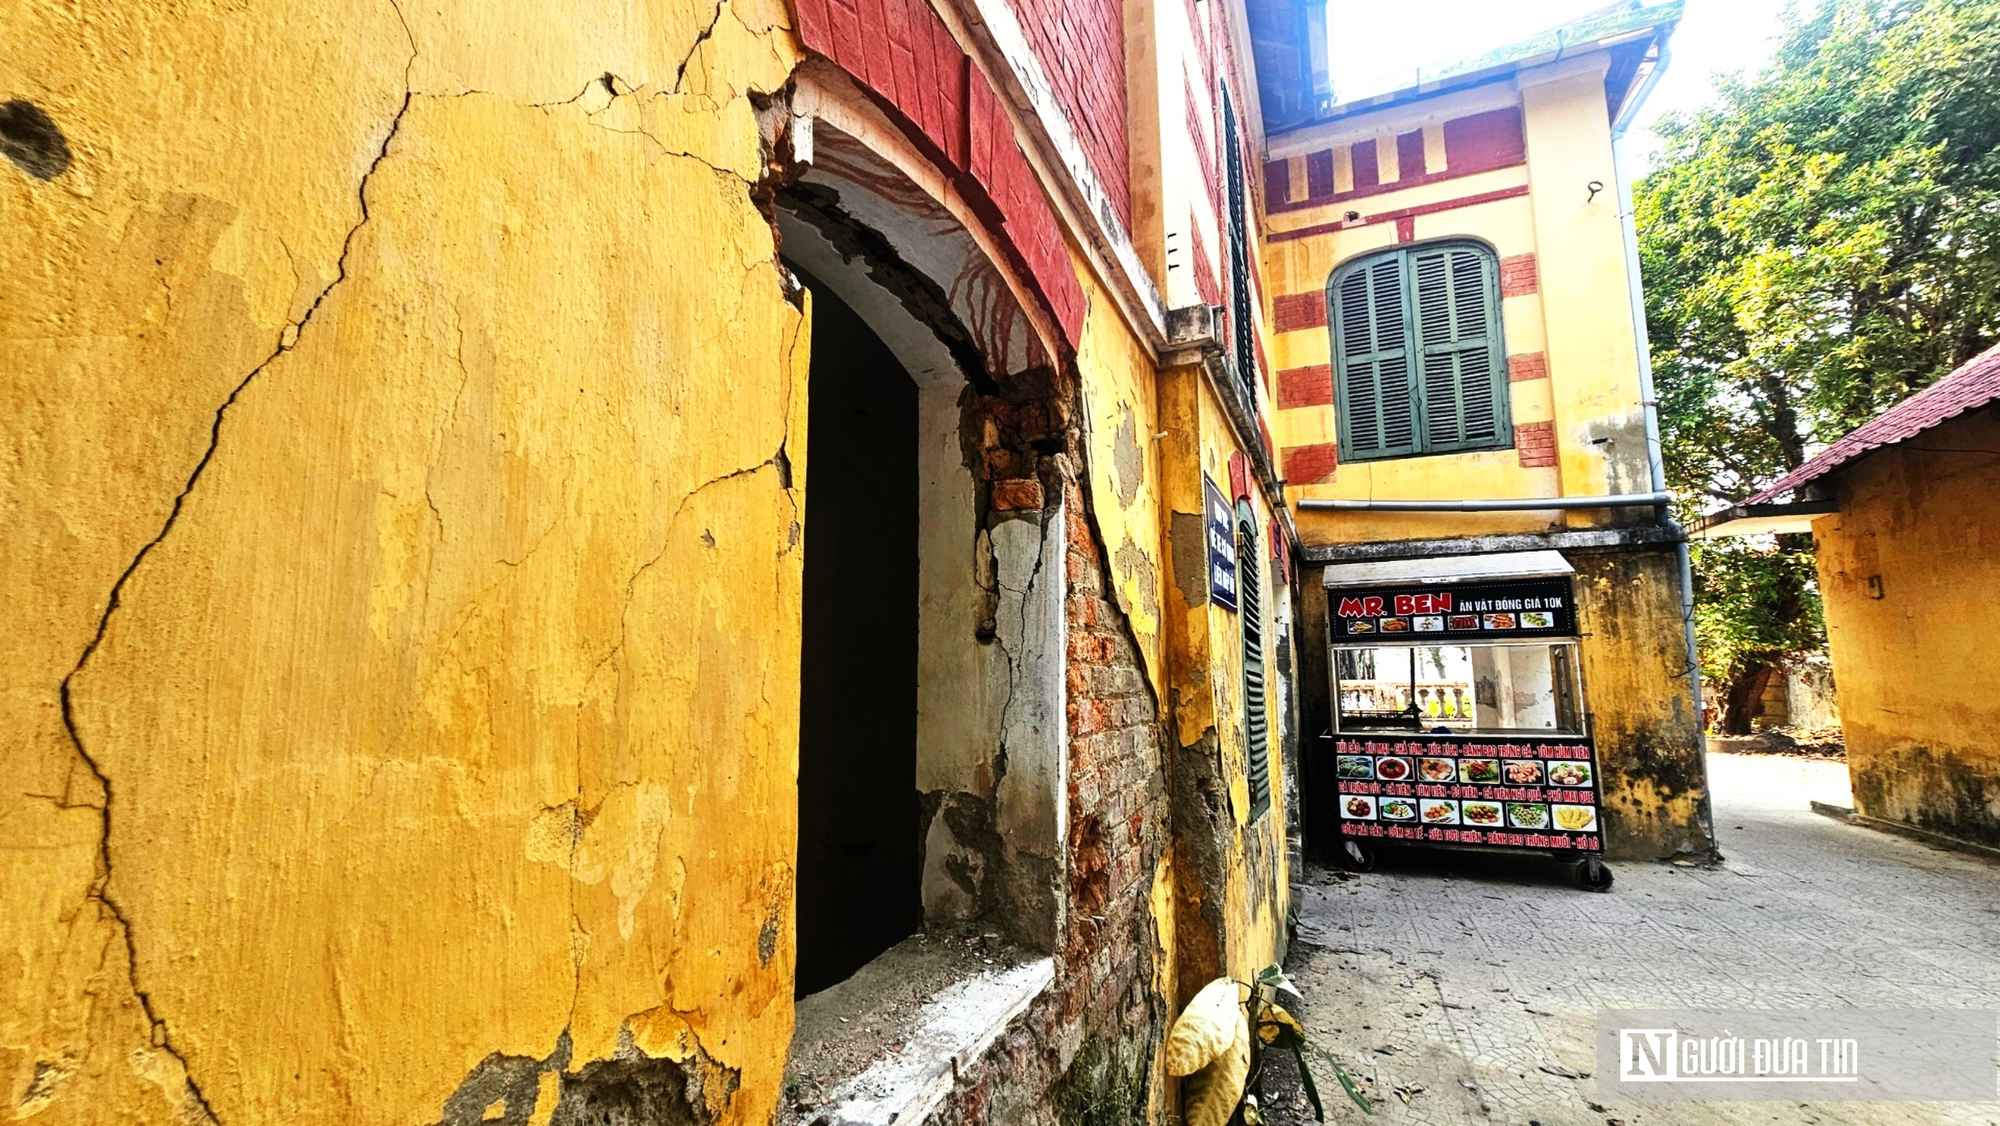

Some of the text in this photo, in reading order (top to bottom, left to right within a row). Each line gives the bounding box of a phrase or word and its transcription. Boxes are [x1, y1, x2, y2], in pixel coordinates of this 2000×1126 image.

[1338, 592, 1452, 618] MR. BEN
[1525, 596, 1542, 609] GIÁ
[1544, 596, 1562, 608] 10K
